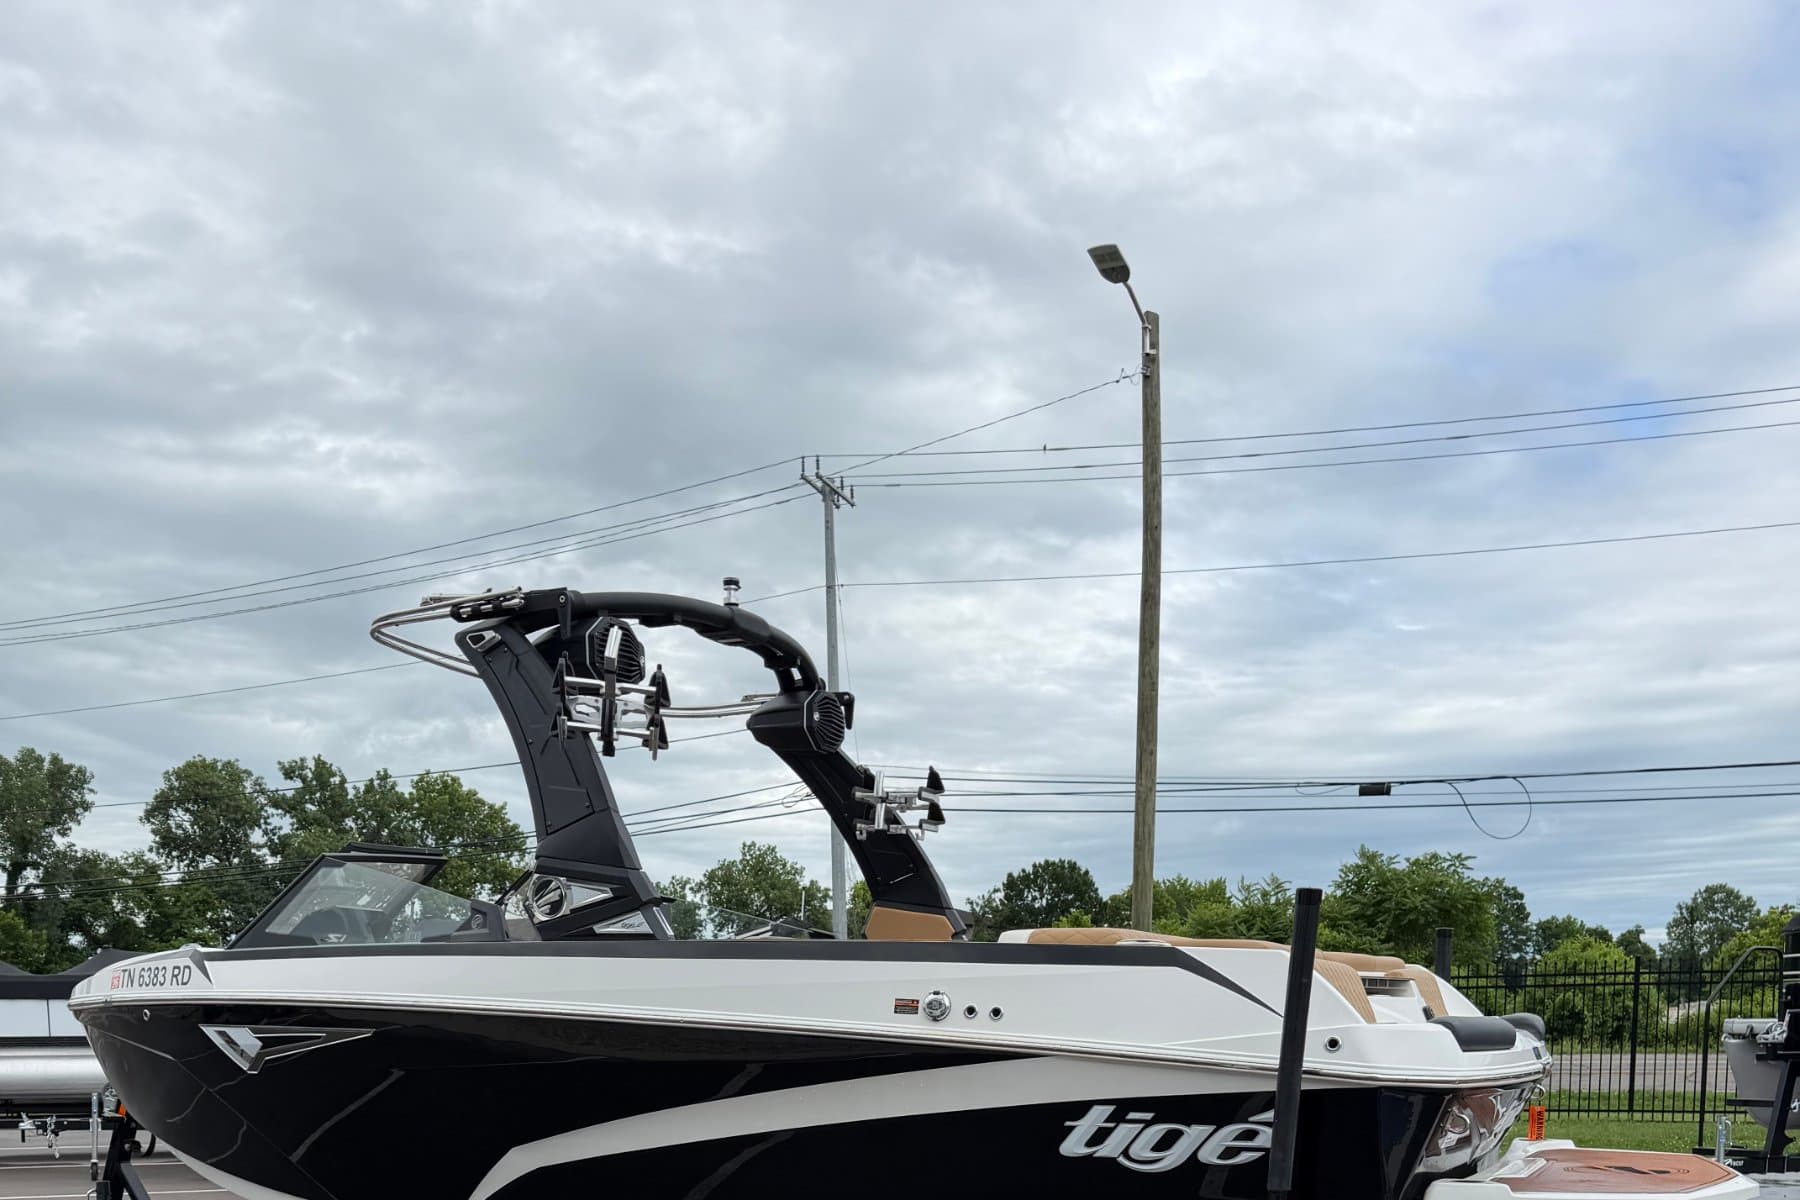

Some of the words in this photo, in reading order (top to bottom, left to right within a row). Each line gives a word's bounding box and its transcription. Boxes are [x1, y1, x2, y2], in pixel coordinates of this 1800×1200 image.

[121, 968, 135, 988] TN
[138, 966, 167, 987] 6383
[170, 965, 192, 986] RD
[1059, 1105, 1274, 1173] tigé
